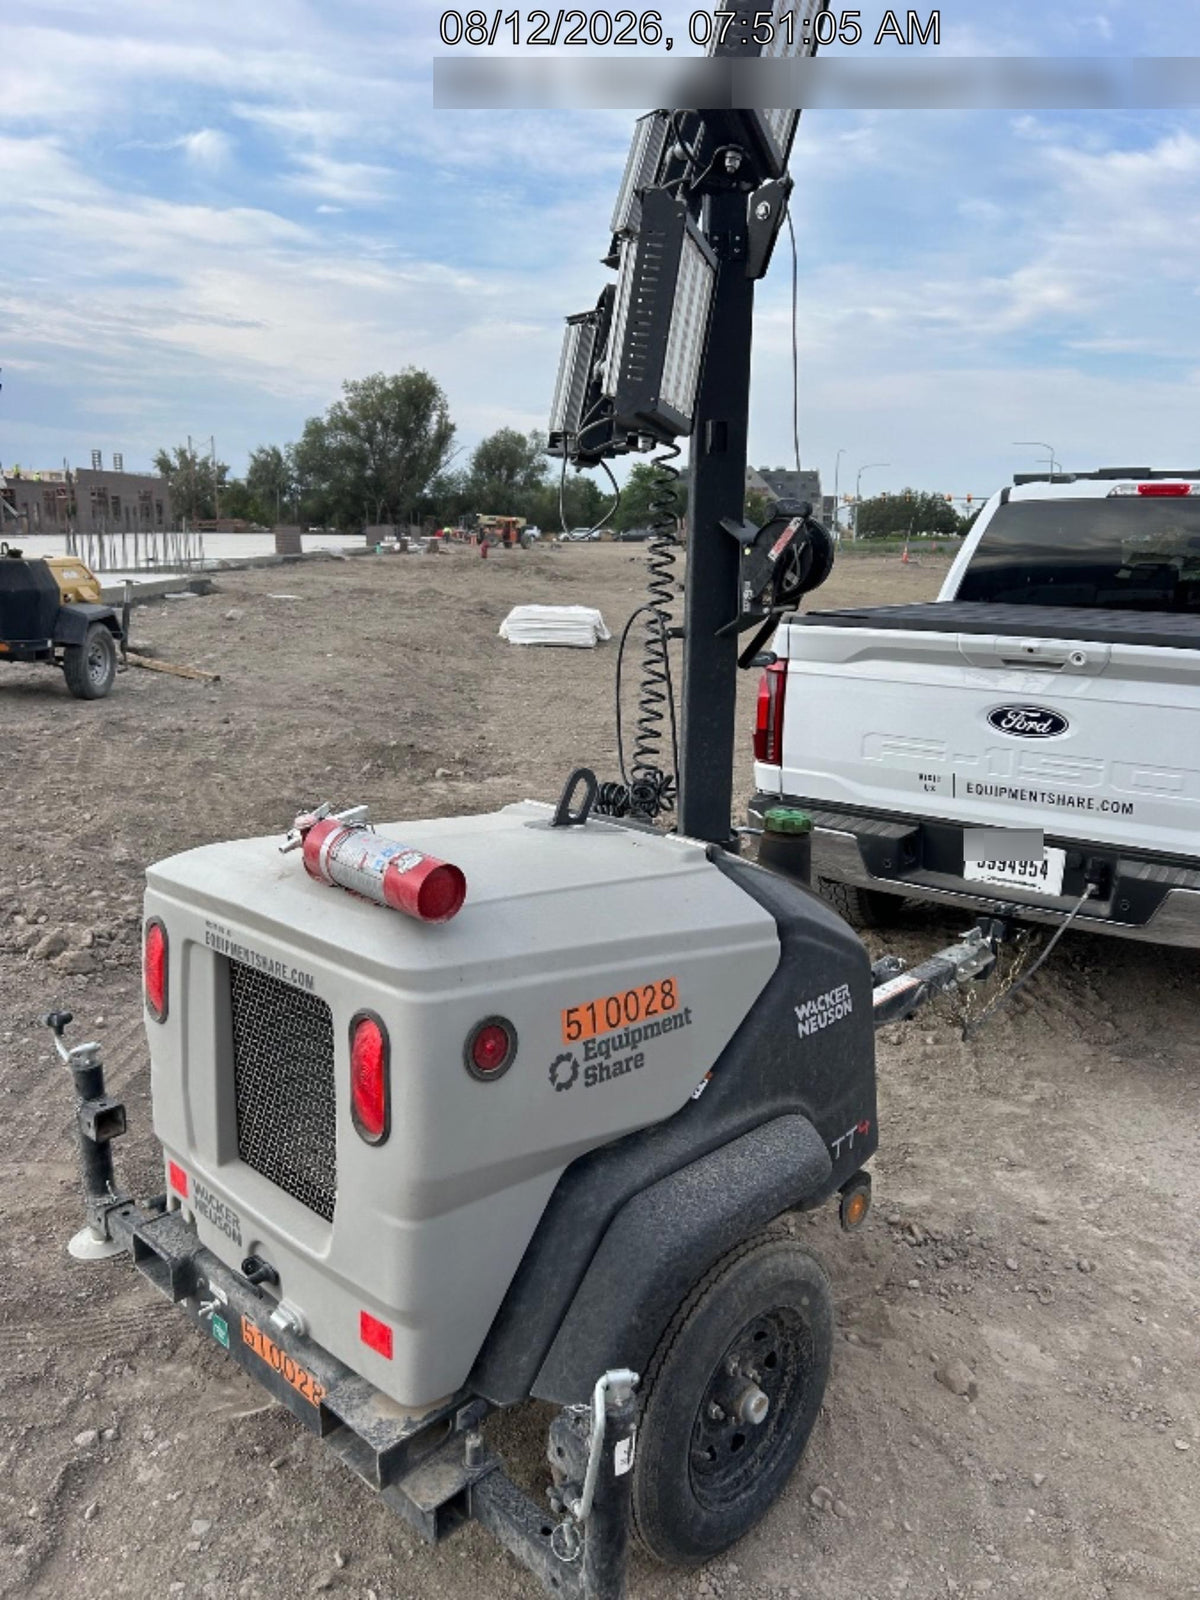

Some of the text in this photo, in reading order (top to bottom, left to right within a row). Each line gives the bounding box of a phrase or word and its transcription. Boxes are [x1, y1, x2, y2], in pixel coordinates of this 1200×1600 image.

[1001, 710, 1053, 733] Ford
[966, 781, 1135, 816] EQUIPMENTSHARE.COM
[565, 978, 677, 1042] 510028
[793, 983, 851, 1021] WACKER
[797, 998, 853, 1039] NEUSON
[582, 1006, 693, 1062] Equipment
[583, 1052, 646, 1088] Share
